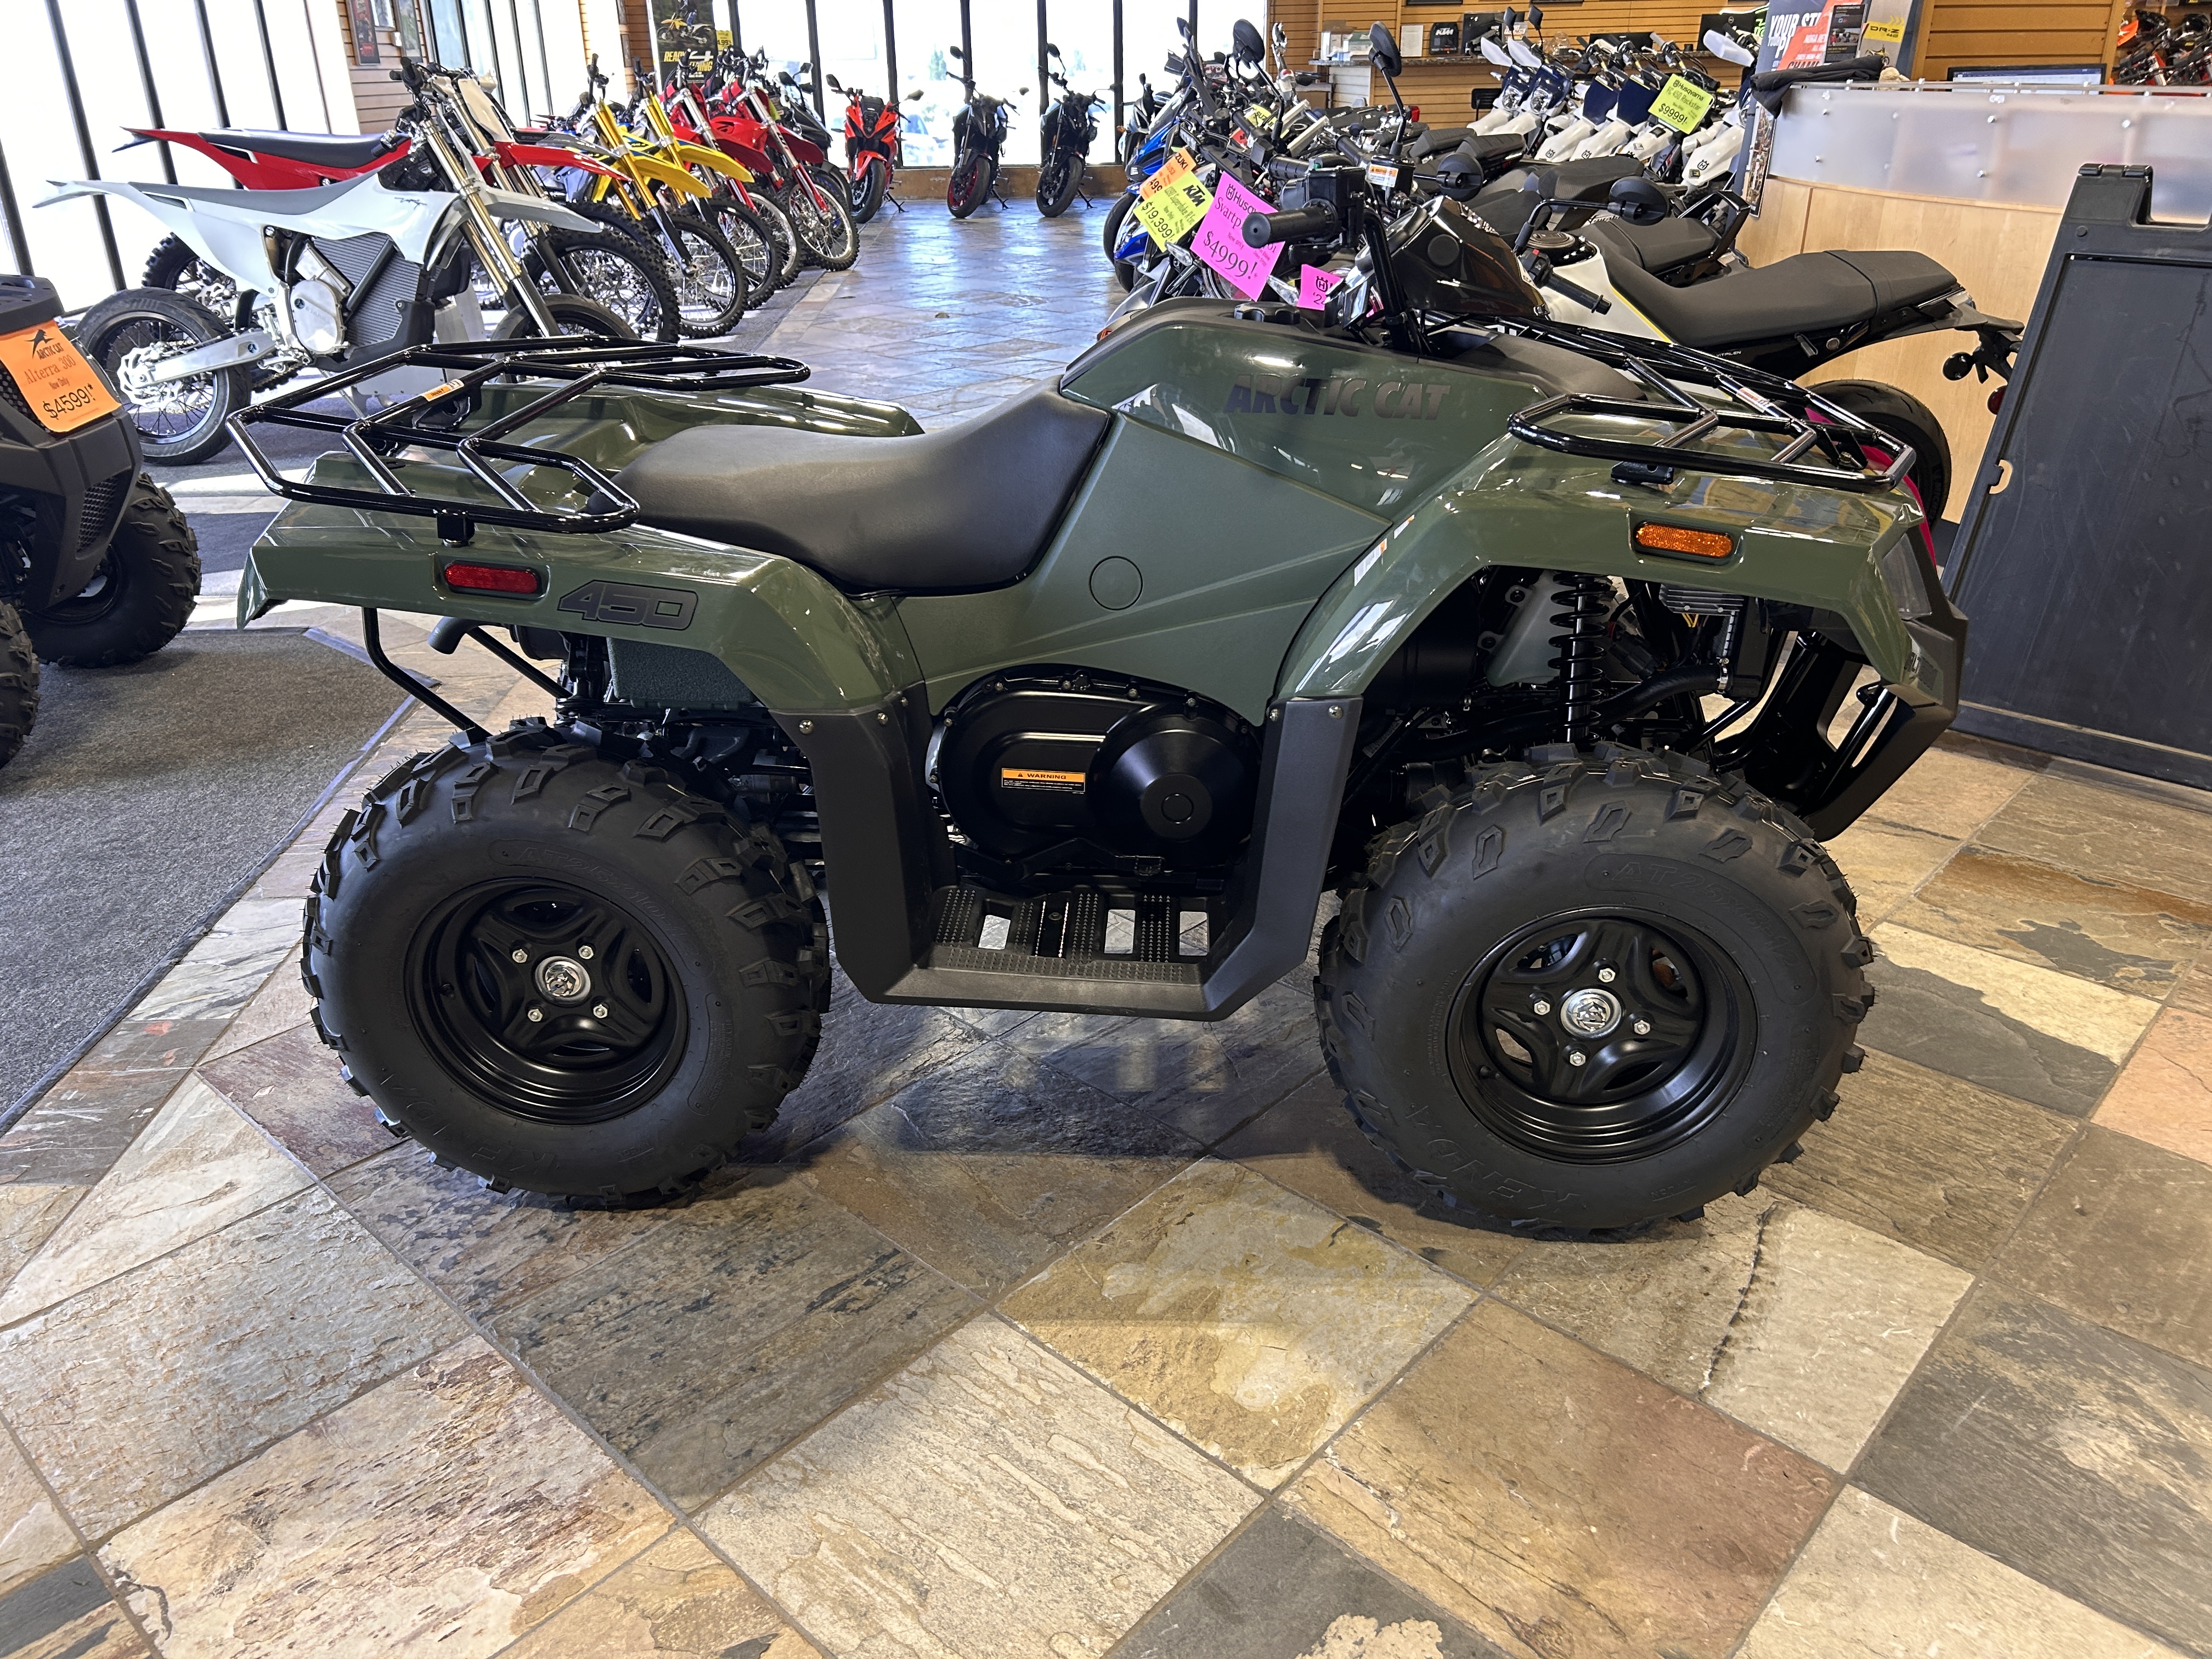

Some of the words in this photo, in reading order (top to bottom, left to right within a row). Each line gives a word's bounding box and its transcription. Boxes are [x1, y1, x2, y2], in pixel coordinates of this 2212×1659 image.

[1435, 27, 1454, 36] KTM
[1768, 14, 1799, 37] YOUR
[1667, 86, 1674, 95] FC
[1673, 90, 1683, 99] 450
[1681, 94, 1701, 110] Rockstar
[1678, 83, 1704, 101] Husqvarna
[1175, 153, 1189, 170] ZUKI
[1182, 184, 1206, 207] KTM
[1215, 197, 1243, 229] Svartp
[36, 343, 55, 360] ARCTIC
[54, 342, 64, 354] CAT
[24, 364, 60, 385] Alterra
[58, 354, 76, 370] 300
[48, 380, 60, 390] Now
[57, 376, 70, 387] Only
[1224, 374, 1367, 417] ARCTIC
[1375, 381, 1451, 420] CAT
[557, 579, 699, 631] 450
